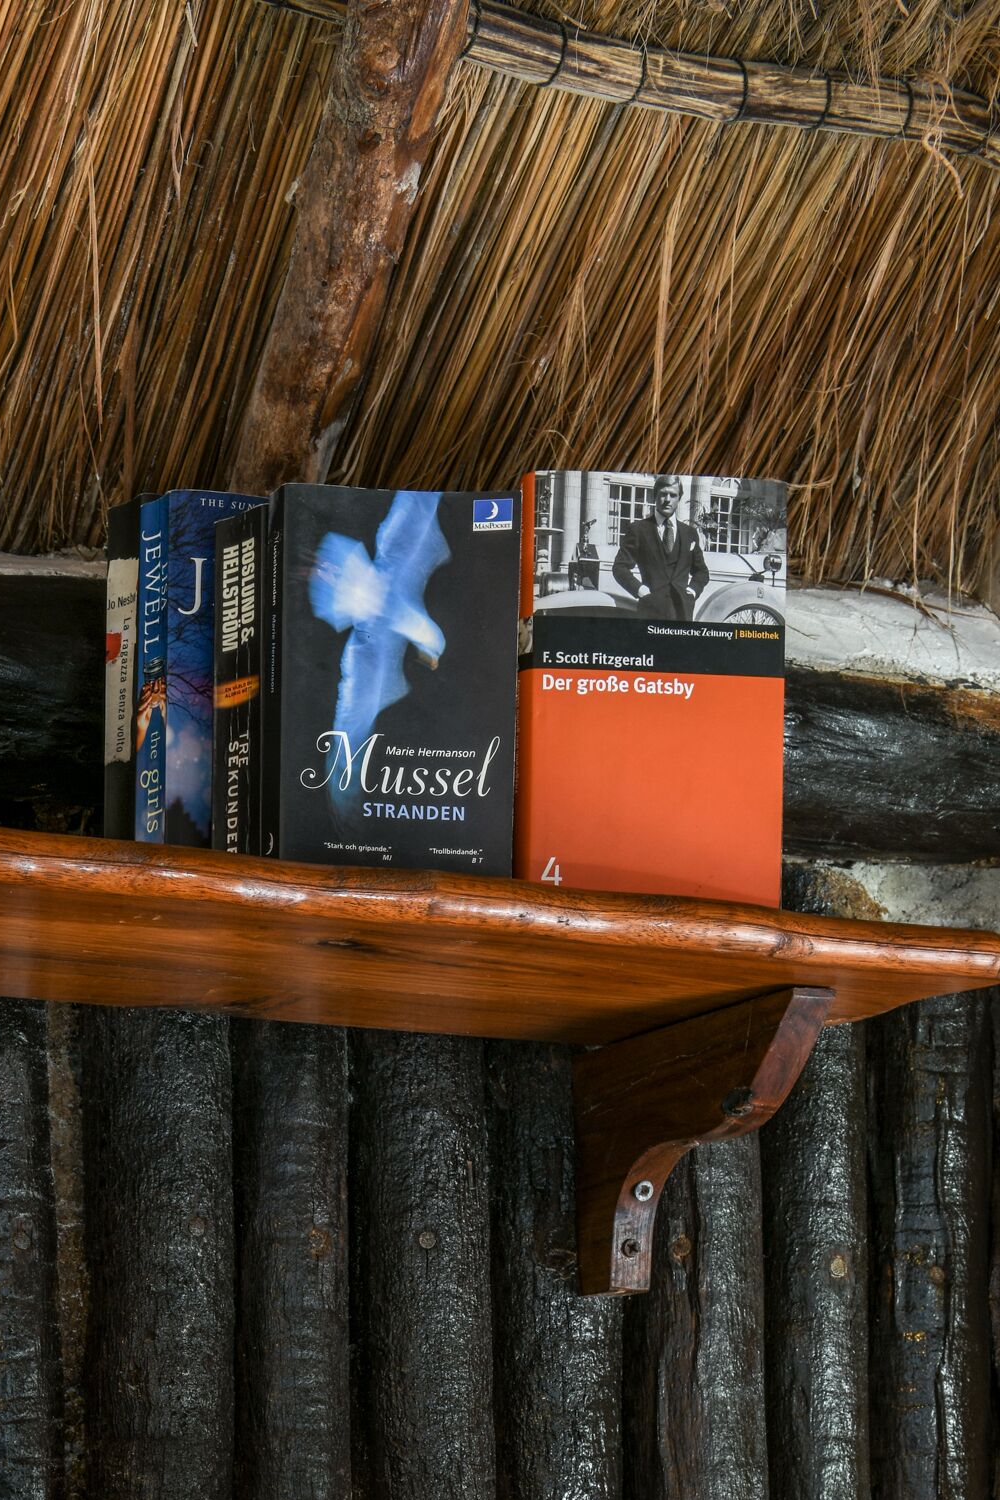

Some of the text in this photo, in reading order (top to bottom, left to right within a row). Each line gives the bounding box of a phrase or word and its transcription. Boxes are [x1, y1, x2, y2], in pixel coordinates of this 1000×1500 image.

[200, 497, 225, 508] THE
[106, 600, 116, 611] Jo
[141, 529, 162, 654] JEWELL
[221, 544, 241, 653] HELLSTRÖM
[240, 536, 255, 645] ROSLUND &
[739, 629, 780, 640] Bibliothek
[542, 651, 654, 668] F. Scott Fitzgerald
[115, 616, 132, 753] La ragazza senza volto
[542, 673, 695, 700] Der große Gatsby
[238, 729, 249, 768] TRE
[300, 731, 500, 797] Mussel
[385, 746, 476, 758] Marie Hermanson
[140, 731, 163, 834] the girls
[363, 802, 465, 821] STRANDEN
[540, 856, 563, 887] 4
